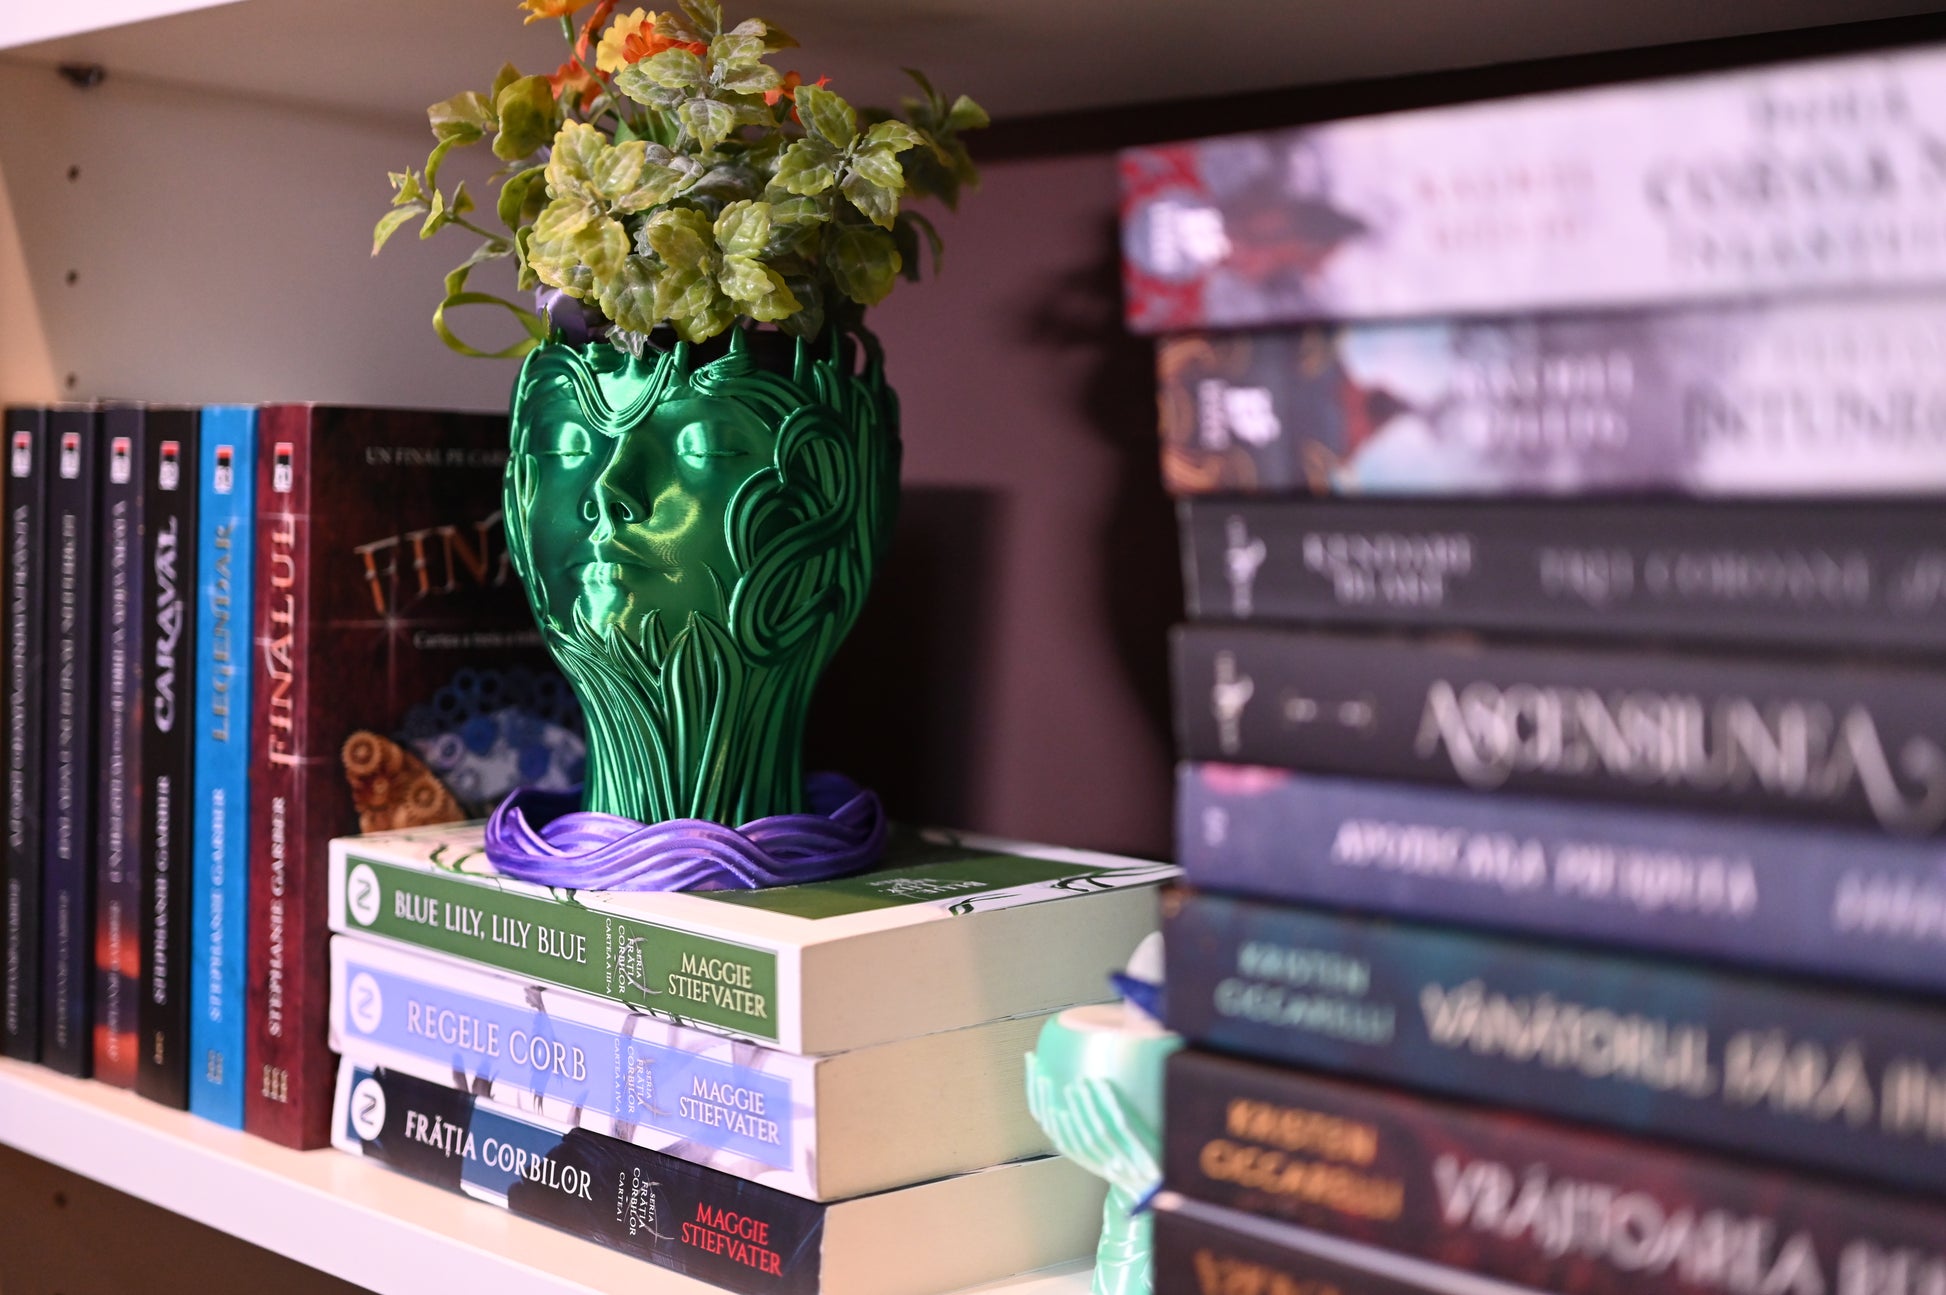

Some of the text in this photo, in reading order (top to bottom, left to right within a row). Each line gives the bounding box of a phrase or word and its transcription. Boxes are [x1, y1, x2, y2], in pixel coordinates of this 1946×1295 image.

[154, 514, 183, 733] CARAVAL
[211, 518, 237, 743] LEGENDAR
[265, 513, 295, 769] FINALUL
[1416, 679, 1912, 832] ASCENSIUNEA
[208, 787, 226, 1022] STEPHANIE GARBER
[268, 796, 286, 1038] STEPHANIE GARBER
[394, 889, 439, 927] BLUE
[444, 902, 485, 941] LILY,
[492, 914, 532, 949] LILY
[537, 925, 587, 964] BLUE
[606, 961, 612, 969] A
[667, 973, 767, 1019] STIEFVATER
[680, 952, 752, 989] MAGGIE
[406, 1000, 500, 1059] REGELE
[508, 1029, 587, 1082] CORB
[627, 1045, 635, 1113] CORBILOR
[692, 1076, 766, 1116] MAGGIE
[678, 1096, 781, 1146] STIEFVATER
[404, 1110, 592, 1201] FRĂȚIA CORBILOR
[616, 1171, 625, 1215] CARTEA
[629, 1167, 641, 1236] CORBILOR
[648, 1192, 656, 1222] SERIA
[695, 1202, 769, 1246] MAGGIE
[681, 1222, 783, 1277] STIEFVATER
